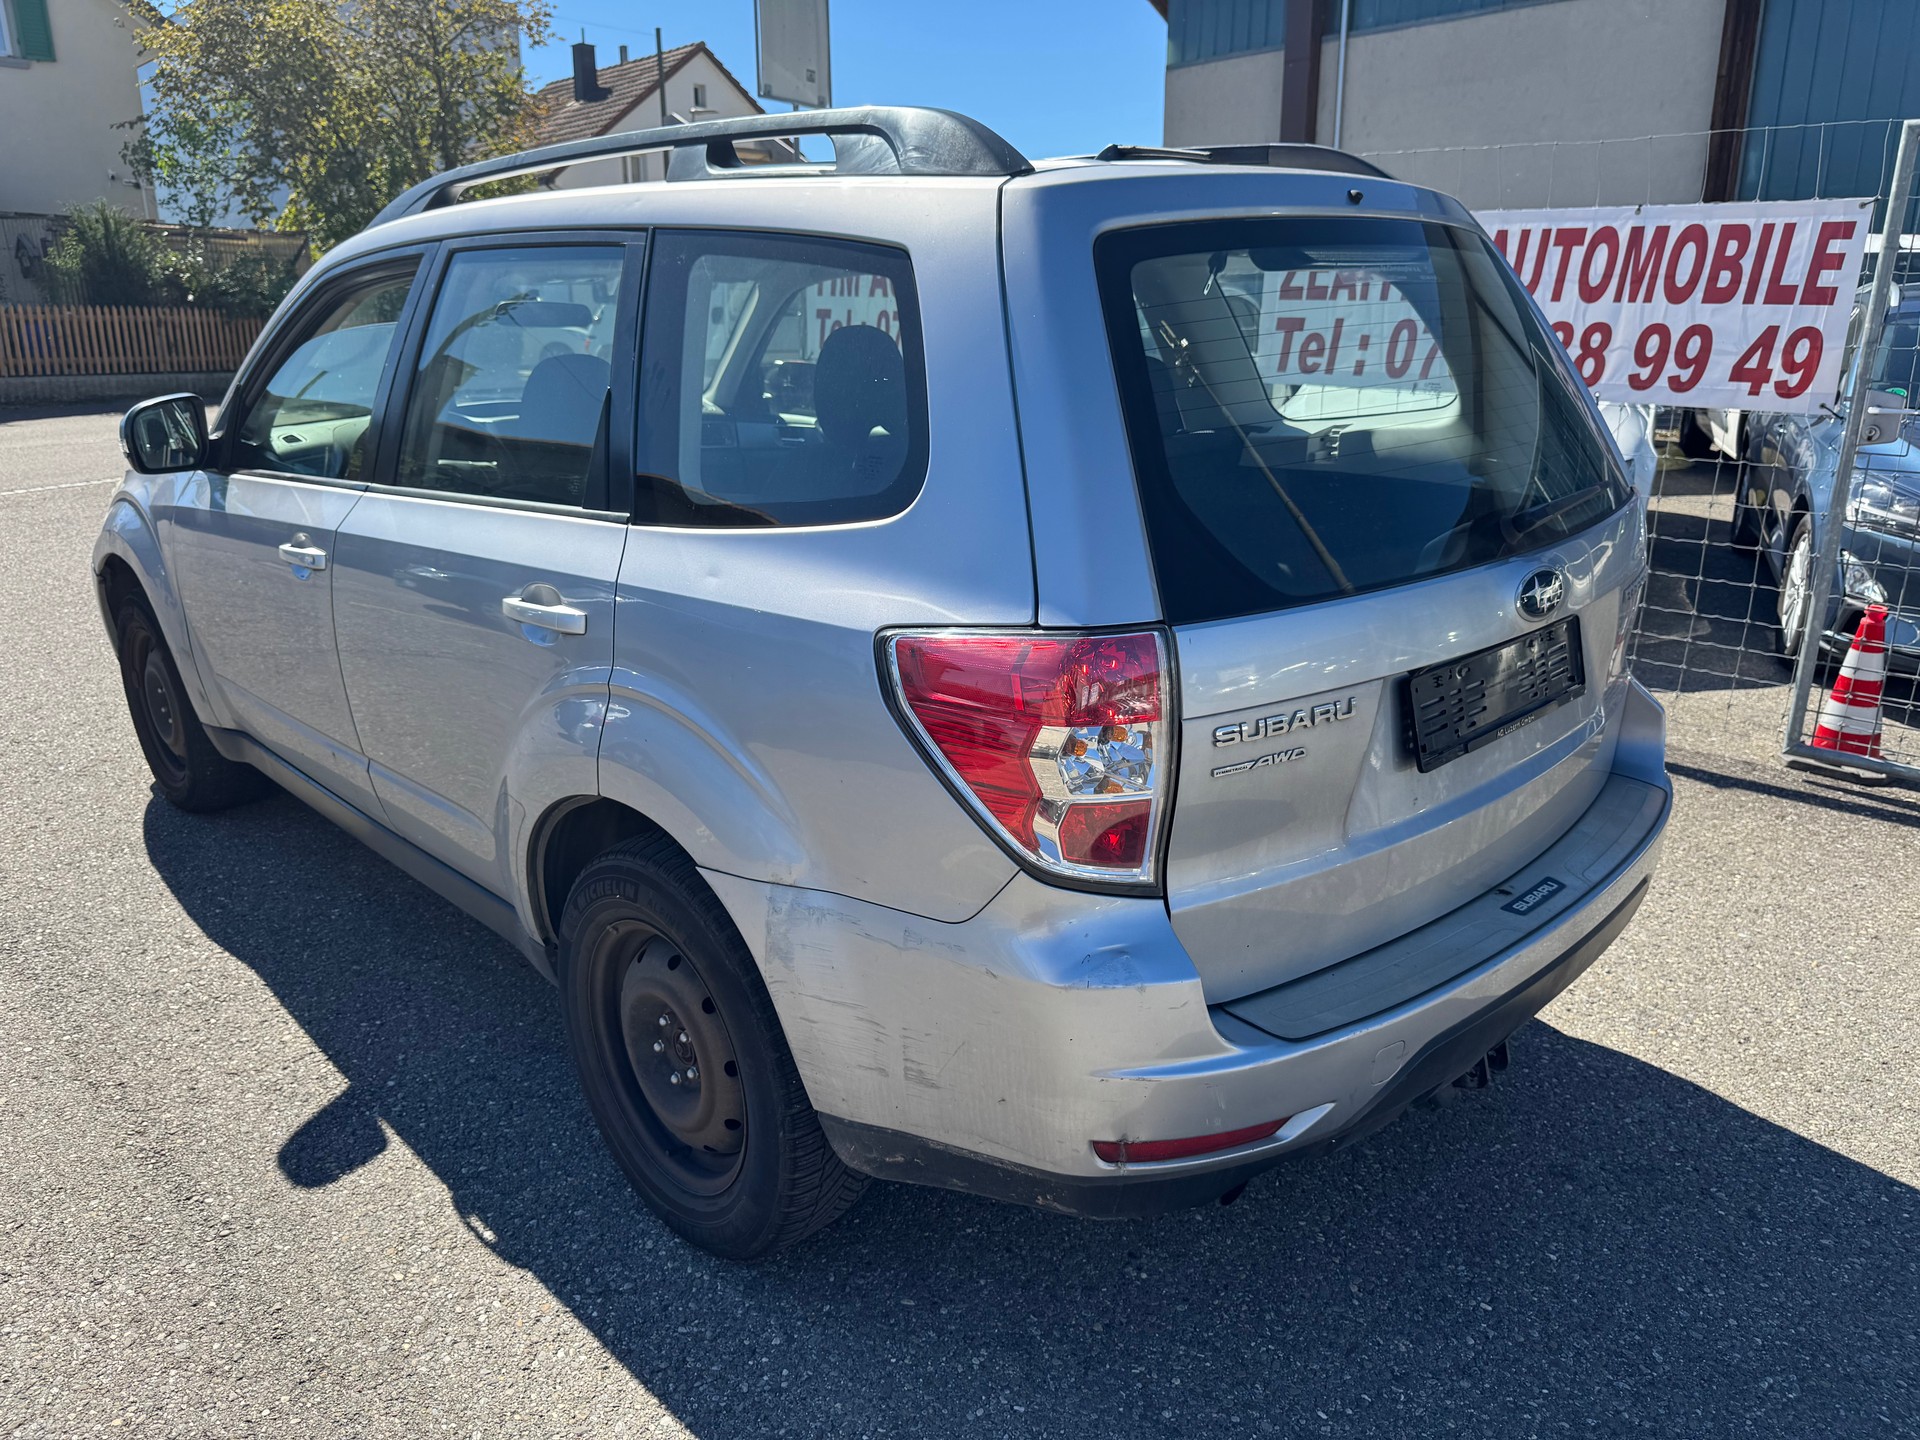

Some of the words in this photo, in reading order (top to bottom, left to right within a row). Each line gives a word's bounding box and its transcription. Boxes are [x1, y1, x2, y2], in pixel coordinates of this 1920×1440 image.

[1493, 220, 1857, 306] UTOMOBILE
[1276, 317, 1344, 376] Tel
[1627, 322, 1713, 393] 99
[1728, 325, 1824, 399] 49
[1213, 696, 1357, 747] SUBARU
[1251, 747, 1307, 769] AWD
[575, 879, 636, 911] MICHELIN
[1512, 881, 1558, 911] SUBARU
